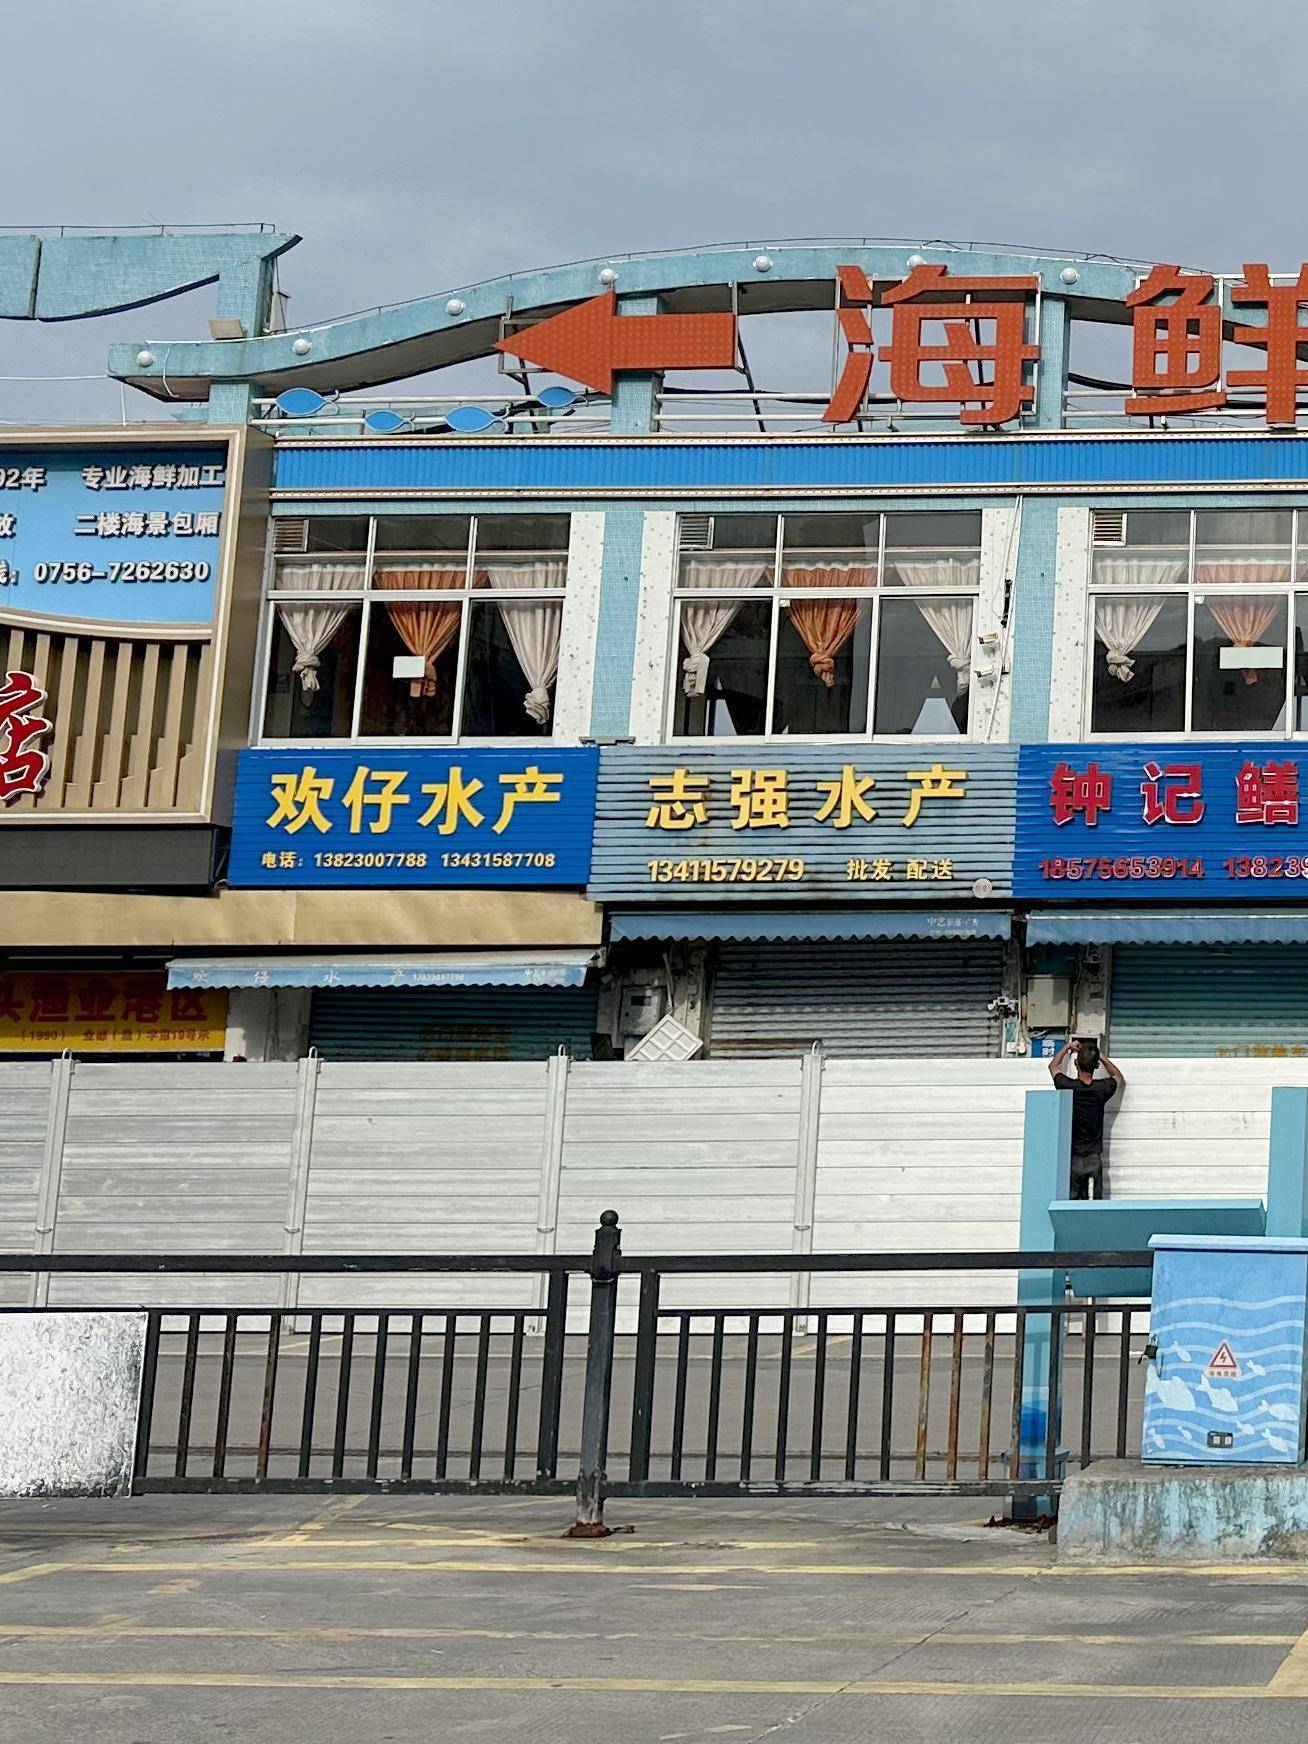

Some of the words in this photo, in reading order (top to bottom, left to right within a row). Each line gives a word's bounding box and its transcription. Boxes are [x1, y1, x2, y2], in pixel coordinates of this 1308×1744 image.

[82, 465, 224, 489] 专业海鲜加工
[74, 512, 221, 537] 二楼海景包厢
[266, 765, 564, 834] 欢仔水产
[645, 764, 968, 830] 志强水产
[440, 853, 555, 868] 13431587708
[647, 859, 804, 882] 13411579279
[847, 858, 893, 881] 批发
[906, 858, 953, 880] 配送
